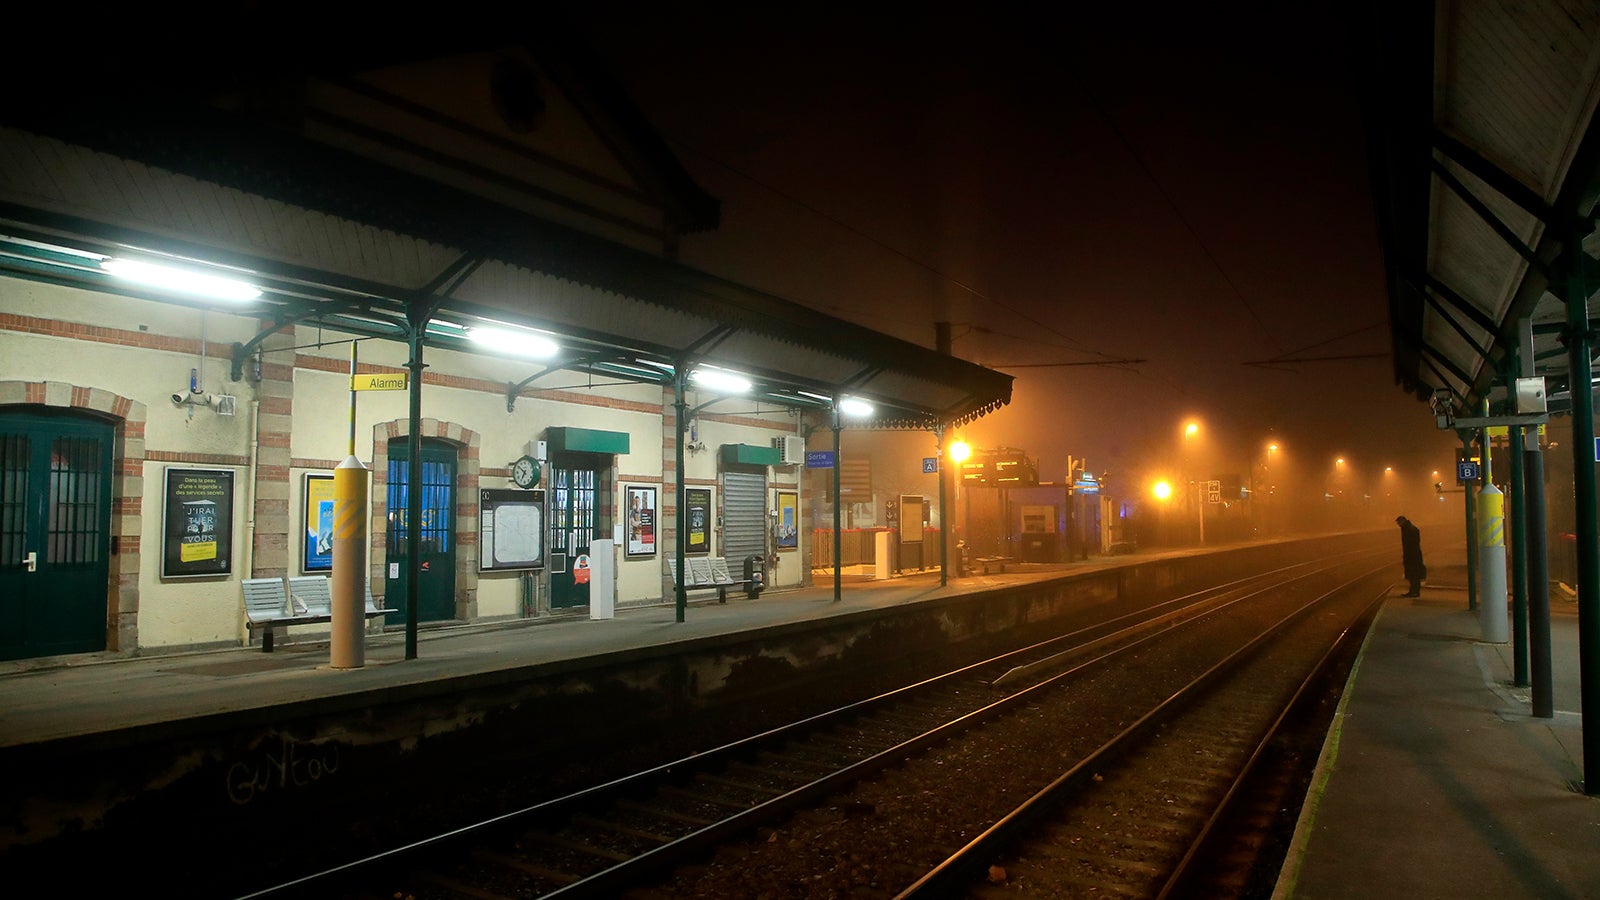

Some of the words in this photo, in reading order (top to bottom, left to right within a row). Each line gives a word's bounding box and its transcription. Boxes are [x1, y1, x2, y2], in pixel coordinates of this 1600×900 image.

[369, 378, 404, 388] Alarme
[926, 463, 933, 471] A
[1464, 468, 1472, 477] B
[187, 507, 215, 515] J'IRAI
[188, 516, 214, 524] TUER
[187, 535, 213, 543] VOUS
